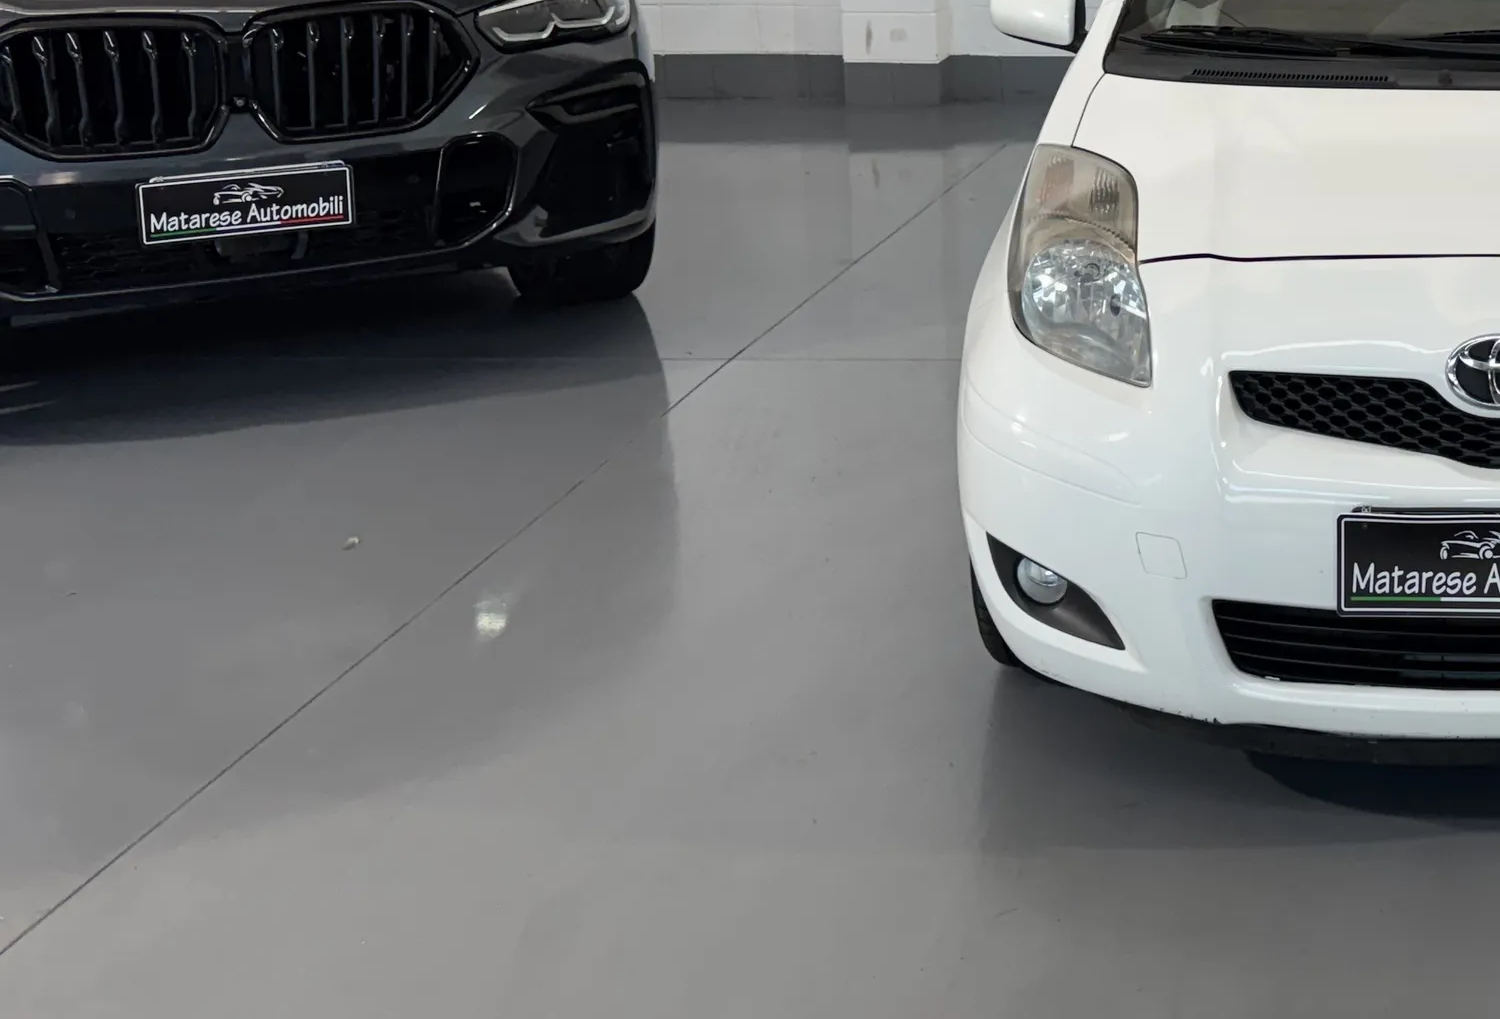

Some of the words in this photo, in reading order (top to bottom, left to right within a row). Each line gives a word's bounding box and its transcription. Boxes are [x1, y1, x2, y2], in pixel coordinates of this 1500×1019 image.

[150, 211, 243, 233] Matarese
[246, 195, 344, 223] Automobili
[1351, 562, 1477, 596] Matarese
